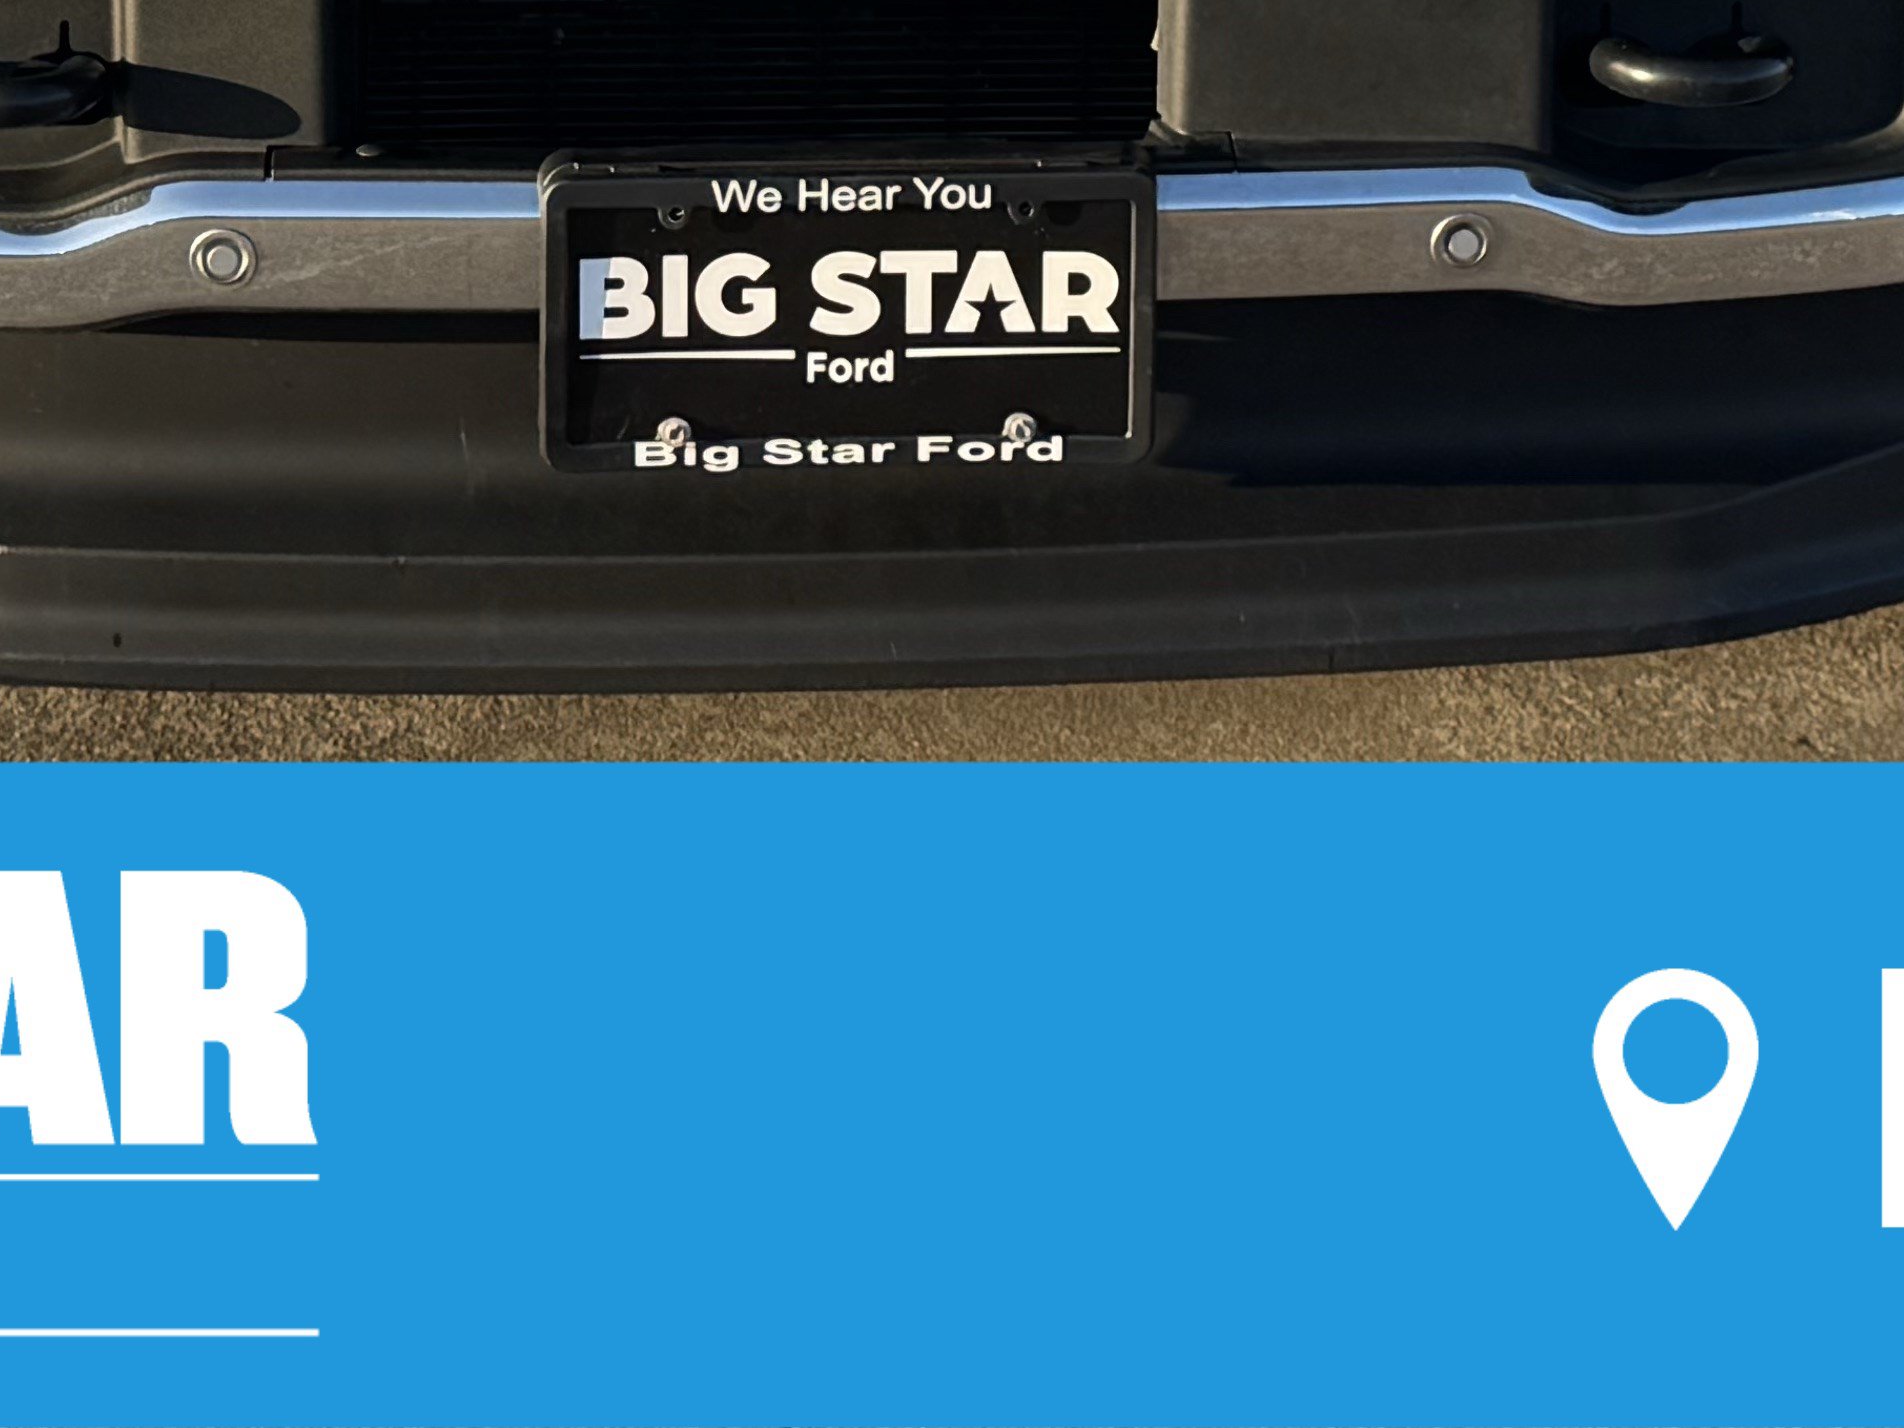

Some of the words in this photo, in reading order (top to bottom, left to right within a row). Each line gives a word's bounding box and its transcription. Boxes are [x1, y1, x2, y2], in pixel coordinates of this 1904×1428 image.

[711, 178, 783, 213] We
[798, 177, 902, 212] Hear
[912, 176, 992, 210] You
[579, 252, 777, 340] BIG
[809, 249, 1120, 336] STAR
[806, 349, 895, 384] Ford
[634, 433, 739, 473] Big
[762, 437, 896, 466] Star
[917, 433, 1063, 462] Ford
